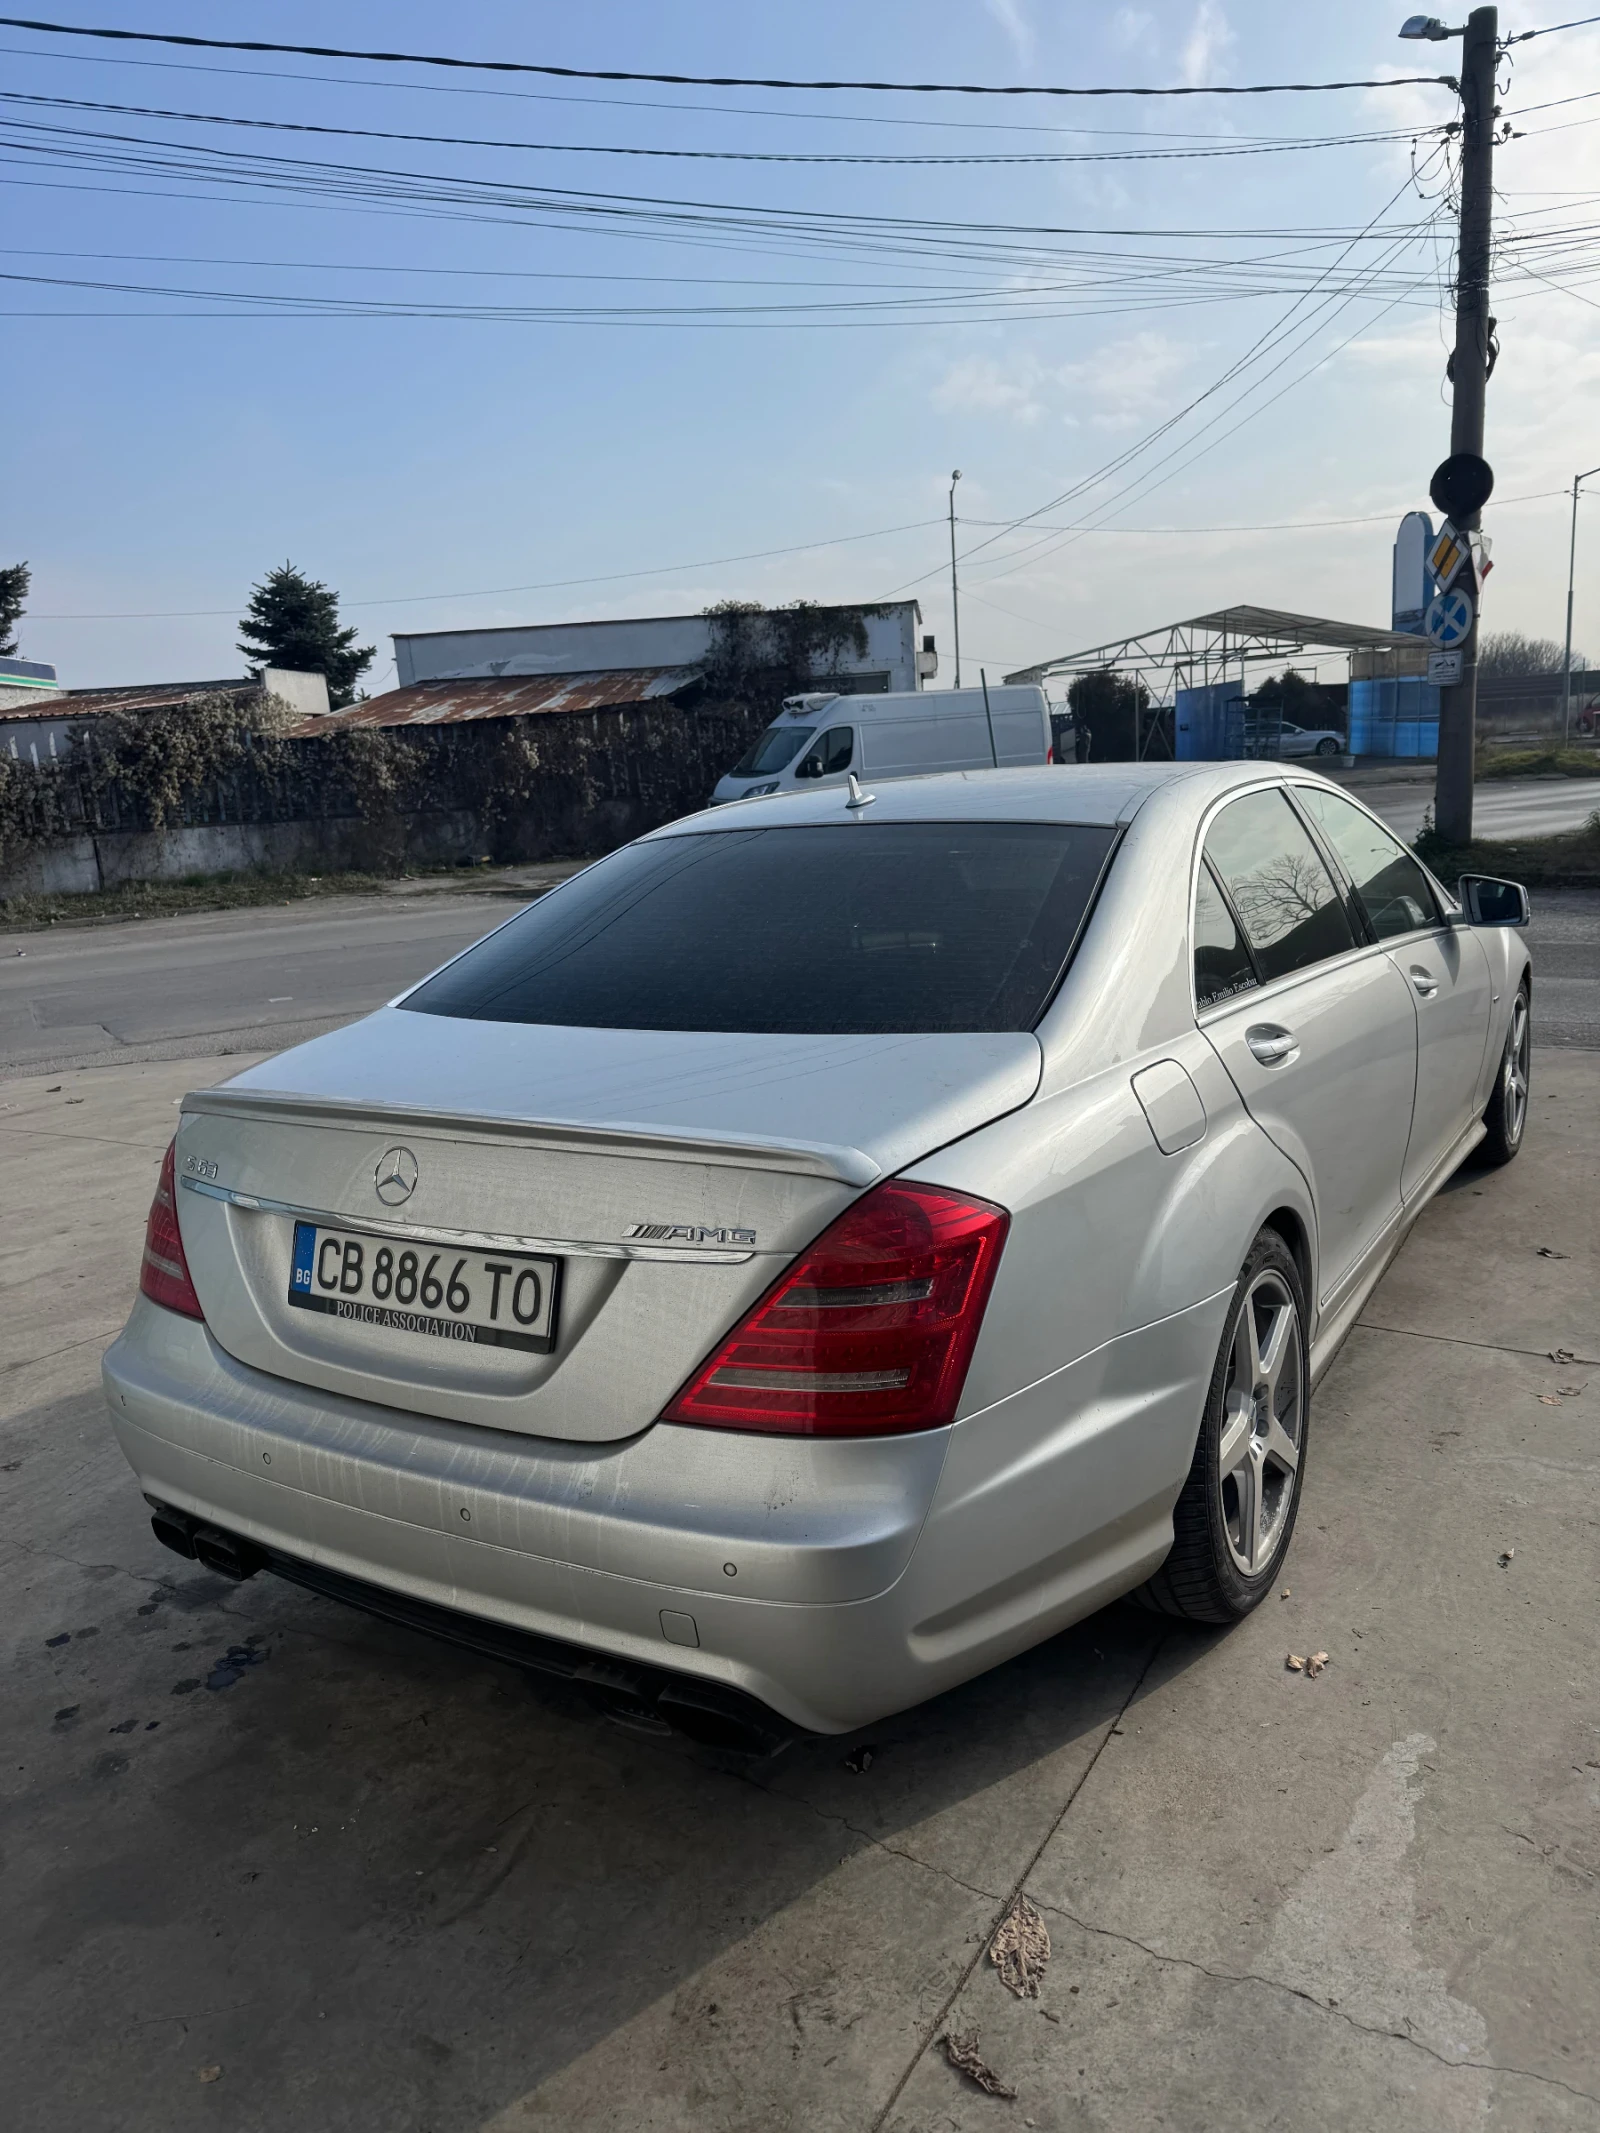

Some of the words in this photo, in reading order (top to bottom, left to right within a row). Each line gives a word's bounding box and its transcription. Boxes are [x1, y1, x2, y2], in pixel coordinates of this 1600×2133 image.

[1197, 996, 1211, 1008] ablo
[1212, 987, 1233, 1002] Emilio
[185, 1155, 196, 1171] S
[197, 1159, 218, 1179] 63
[662, 1224, 756, 1244] AMG
[295, 1267, 311, 1285] BG
[318, 1238, 363, 1294] CB
[372, 1247, 469, 1313] 8866
[484, 1262, 541, 1325] TO
[336, 1301, 381, 1324] POLICE
[382, 1311, 477, 1342] ASSOCIATION
